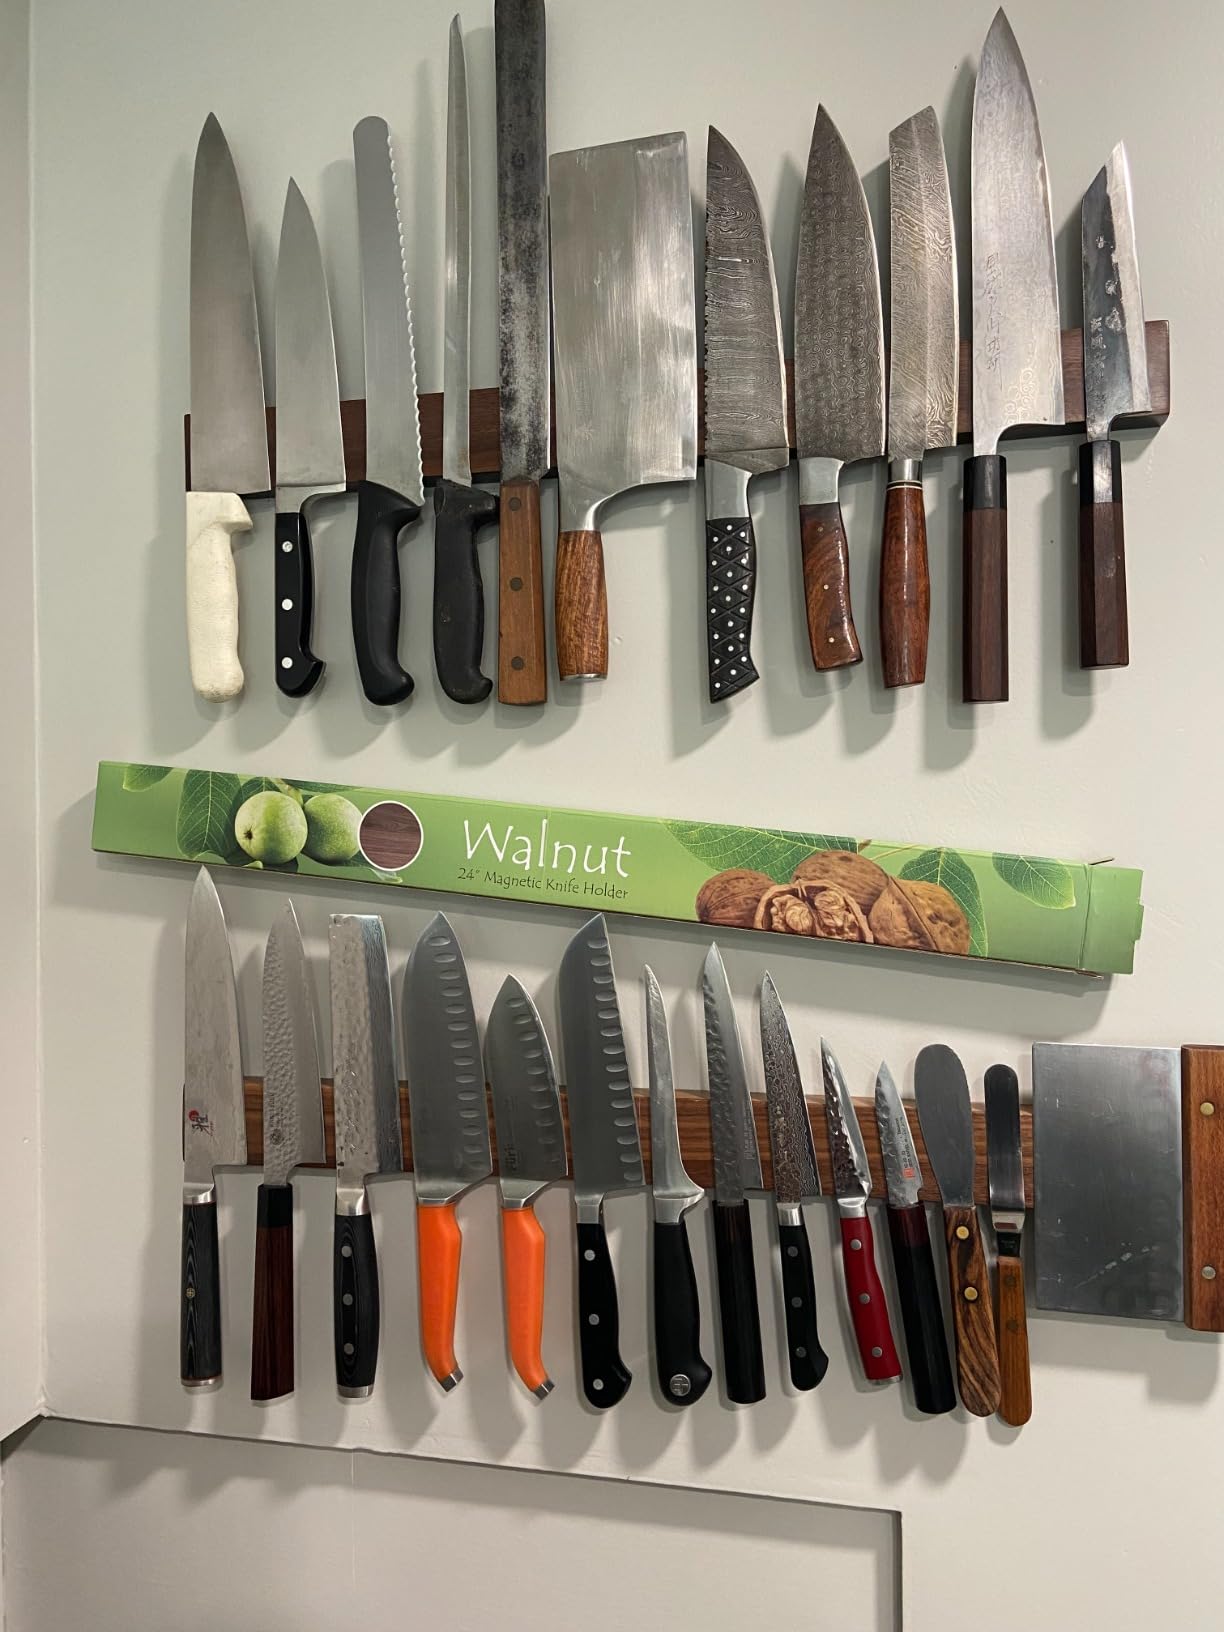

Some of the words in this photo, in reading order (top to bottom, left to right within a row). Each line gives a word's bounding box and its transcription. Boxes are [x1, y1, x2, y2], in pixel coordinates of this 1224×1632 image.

[463, 818, 632, 878] Walnut
[484, 871, 542, 890] Magnetic
[546, 877, 580, 894] Knife
[583, 881, 629, 899] Holder
